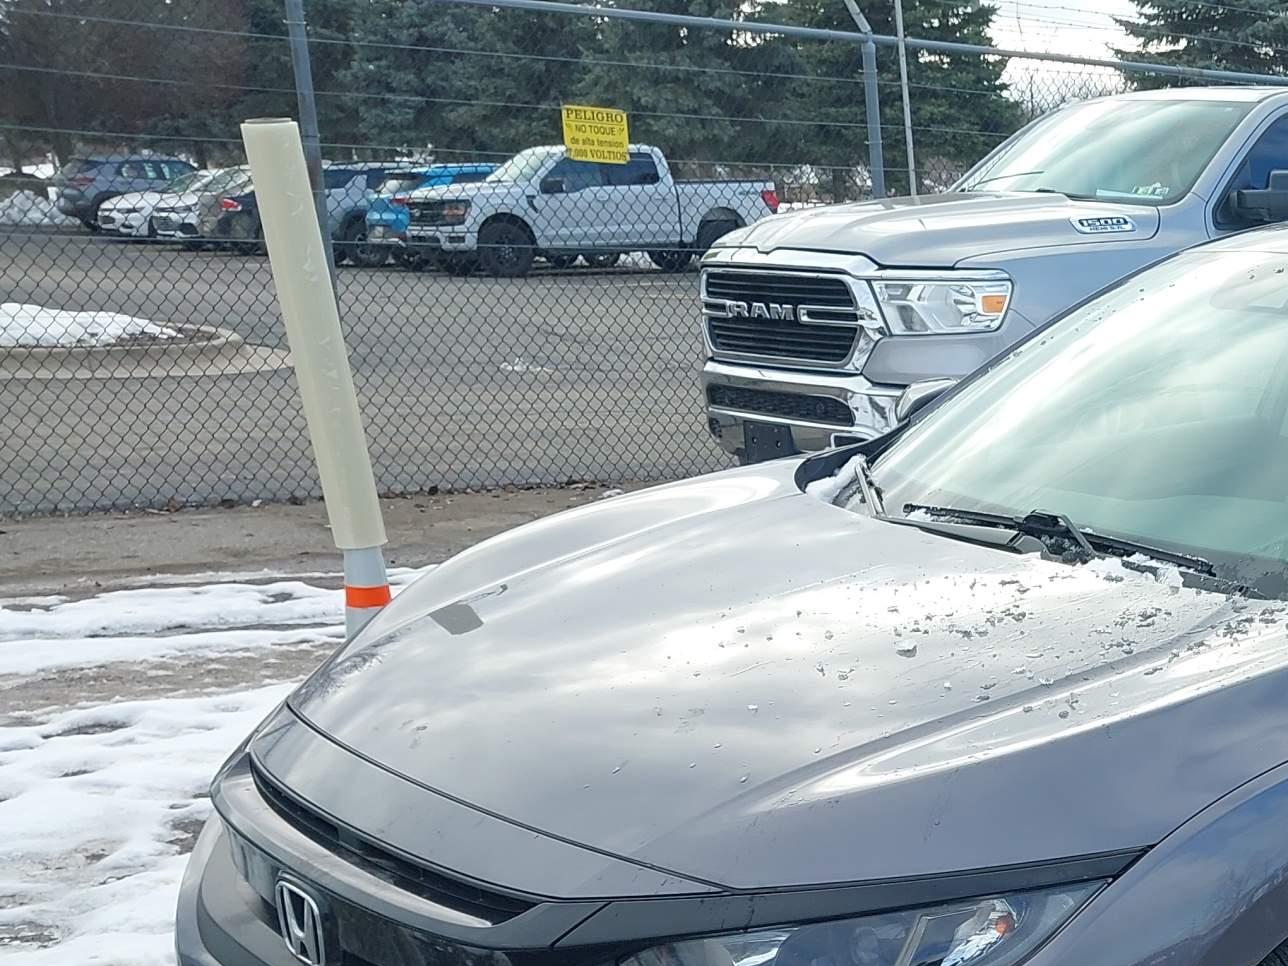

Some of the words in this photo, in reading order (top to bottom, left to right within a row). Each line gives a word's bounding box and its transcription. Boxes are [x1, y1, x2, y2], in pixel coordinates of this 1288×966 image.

[566, 108, 624, 123] PELIGRO
[575, 124, 587, 134] NO
[588, 125, 617, 136] TOQUE
[589, 149, 627, 161] VOLTIOS
[1081, 218, 1125, 227] 1500
[729, 300, 794, 321] RAM
